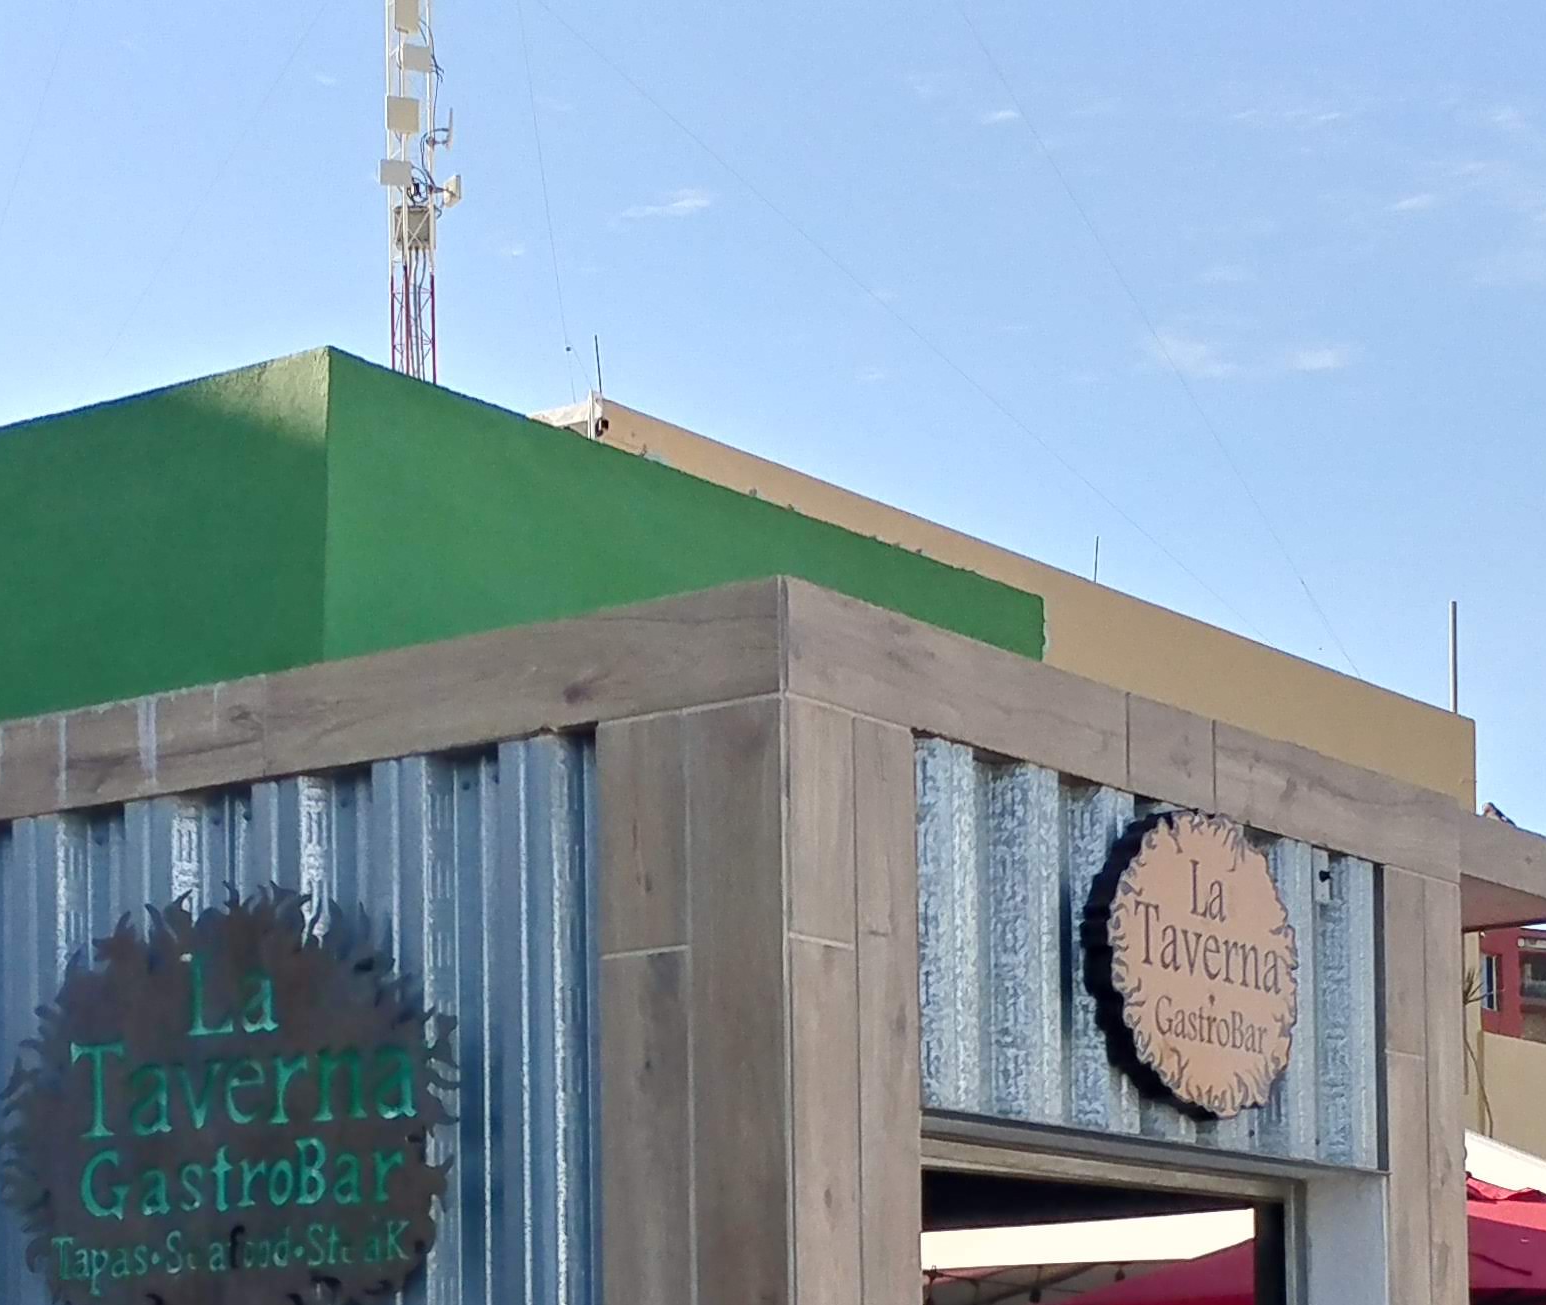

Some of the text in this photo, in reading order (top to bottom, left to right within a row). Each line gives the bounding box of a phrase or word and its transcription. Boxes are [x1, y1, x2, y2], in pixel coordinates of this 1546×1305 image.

[1189, 859, 1227, 922] La
[1134, 899, 1284, 995] Taverna
[186, 956, 279, 1037] La
[1154, 996, 1268, 1055] GastroBar
[69, 1043, 418, 1141] Taverna
[79, 1137, 405, 1220] GastroBar
[51, 1236, 149, 1296] Tapas
